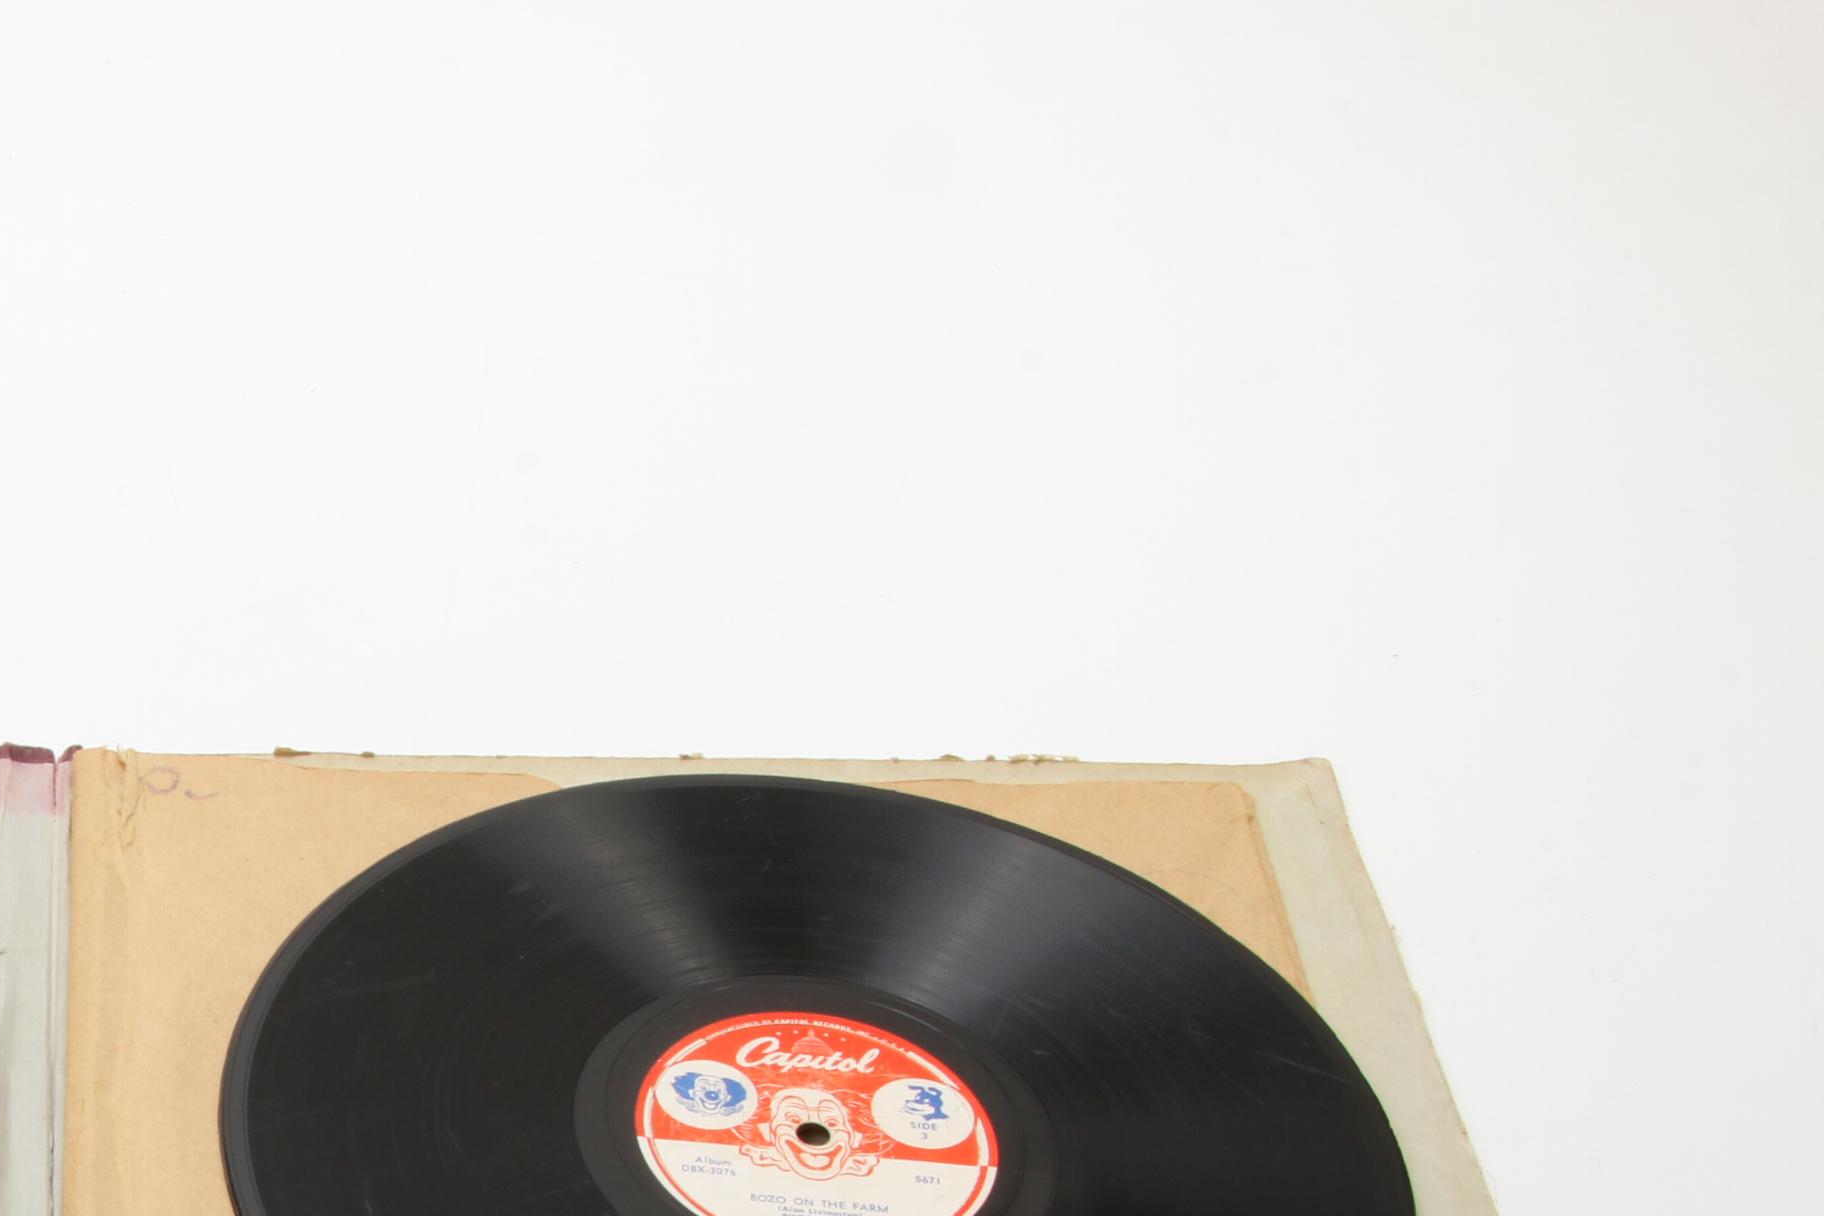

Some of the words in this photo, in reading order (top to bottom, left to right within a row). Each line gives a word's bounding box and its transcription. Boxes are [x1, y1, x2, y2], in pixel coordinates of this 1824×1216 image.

[736, 1036, 880, 1074] Capitol
[909, 1120, 939, 1132] SIDE
[920, 1131, 929, 1141] 3
[695, 1155, 733, 1167] Album
[680, 1163, 737, 1177] DBX-3076
[914, 1174, 941, 1186] 5671
[749, 1193, 788, 1205] BOZO
[793, 1196, 815, 1207] ON
[821, 1199, 847, 1210] THE
[852, 1201, 889, 1214] FARM
